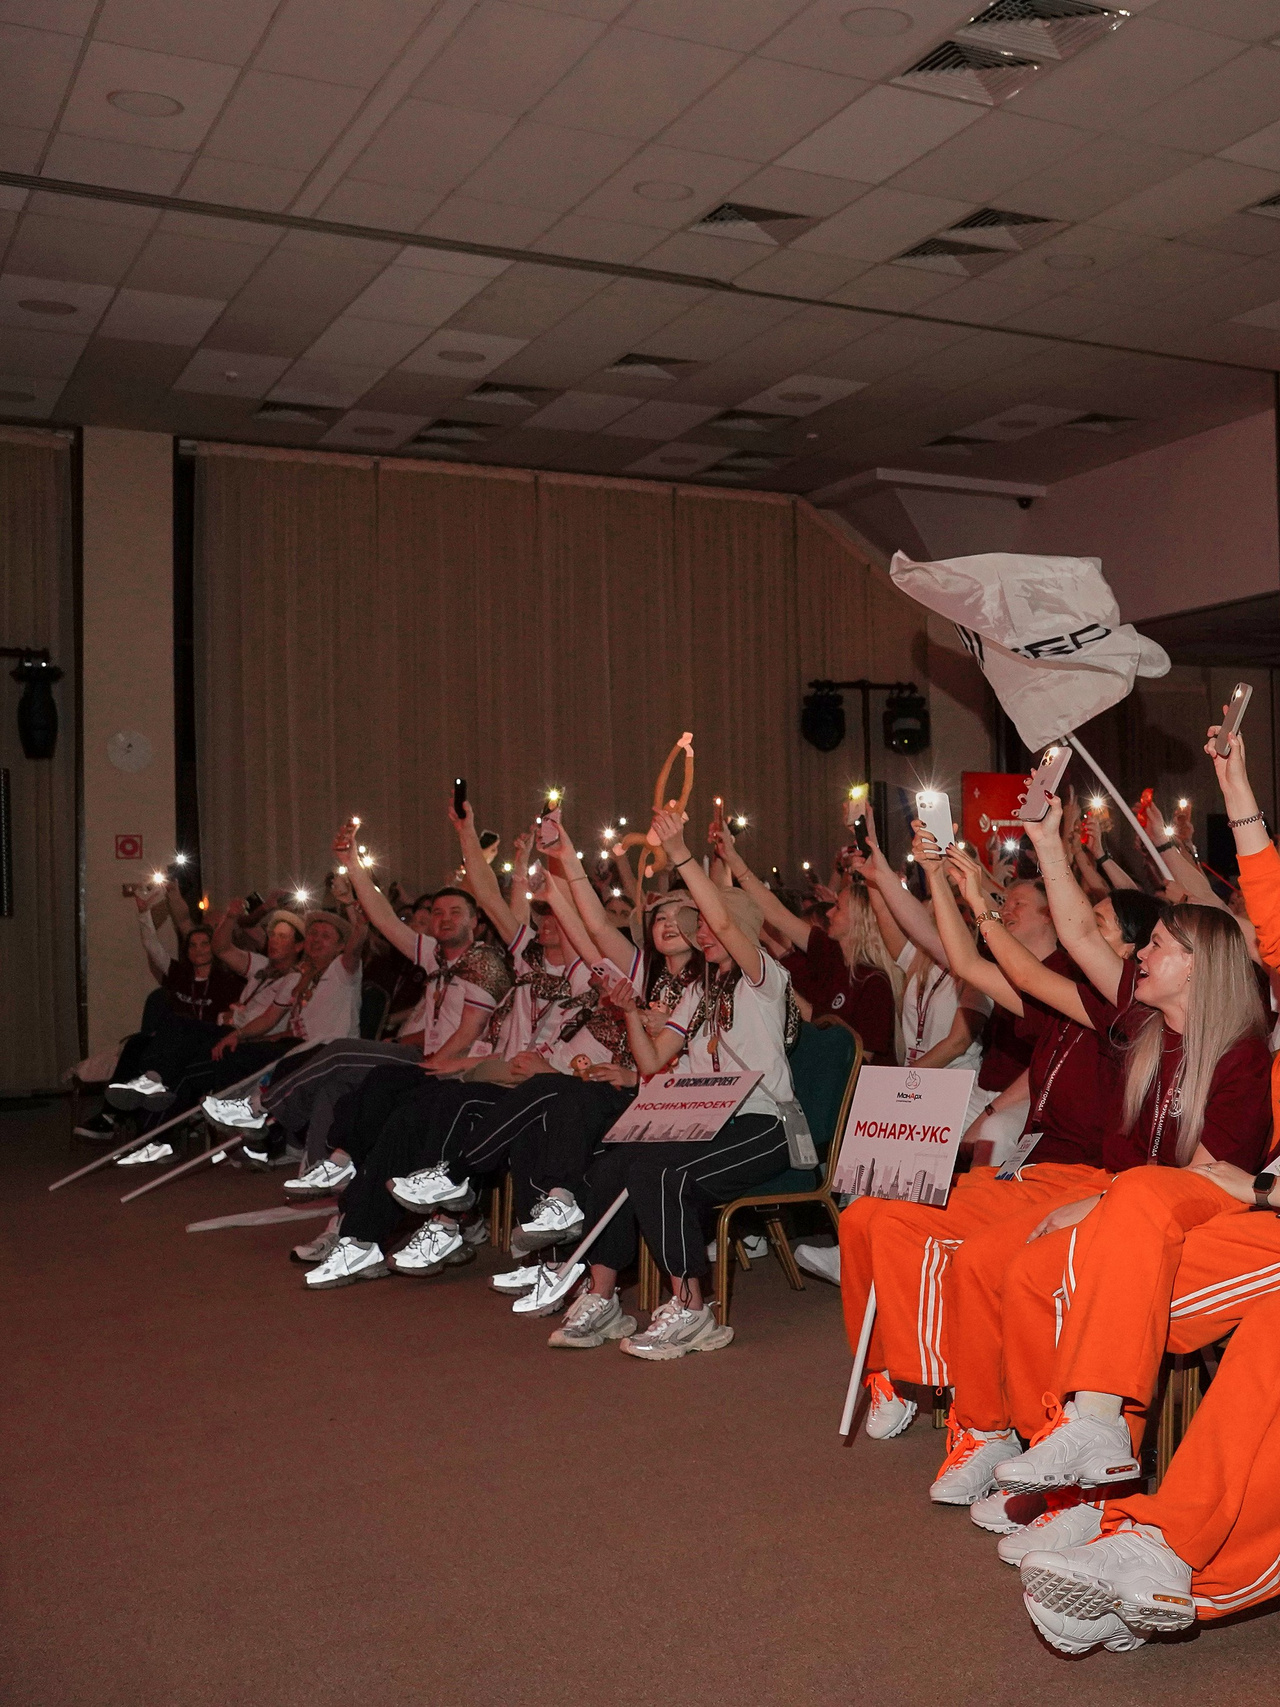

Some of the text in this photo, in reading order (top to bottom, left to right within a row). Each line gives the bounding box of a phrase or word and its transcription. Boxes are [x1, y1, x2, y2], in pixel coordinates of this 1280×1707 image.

[673, 1076, 741, 1088] МОСИНЖПРОЕКТ
[896, 1092, 923, 1100] МонАрх
[633, 1100, 737, 1111] МОСИНЖПРОЕКТ
[854, 1120, 951, 1144] МОНАРХ-УКС
